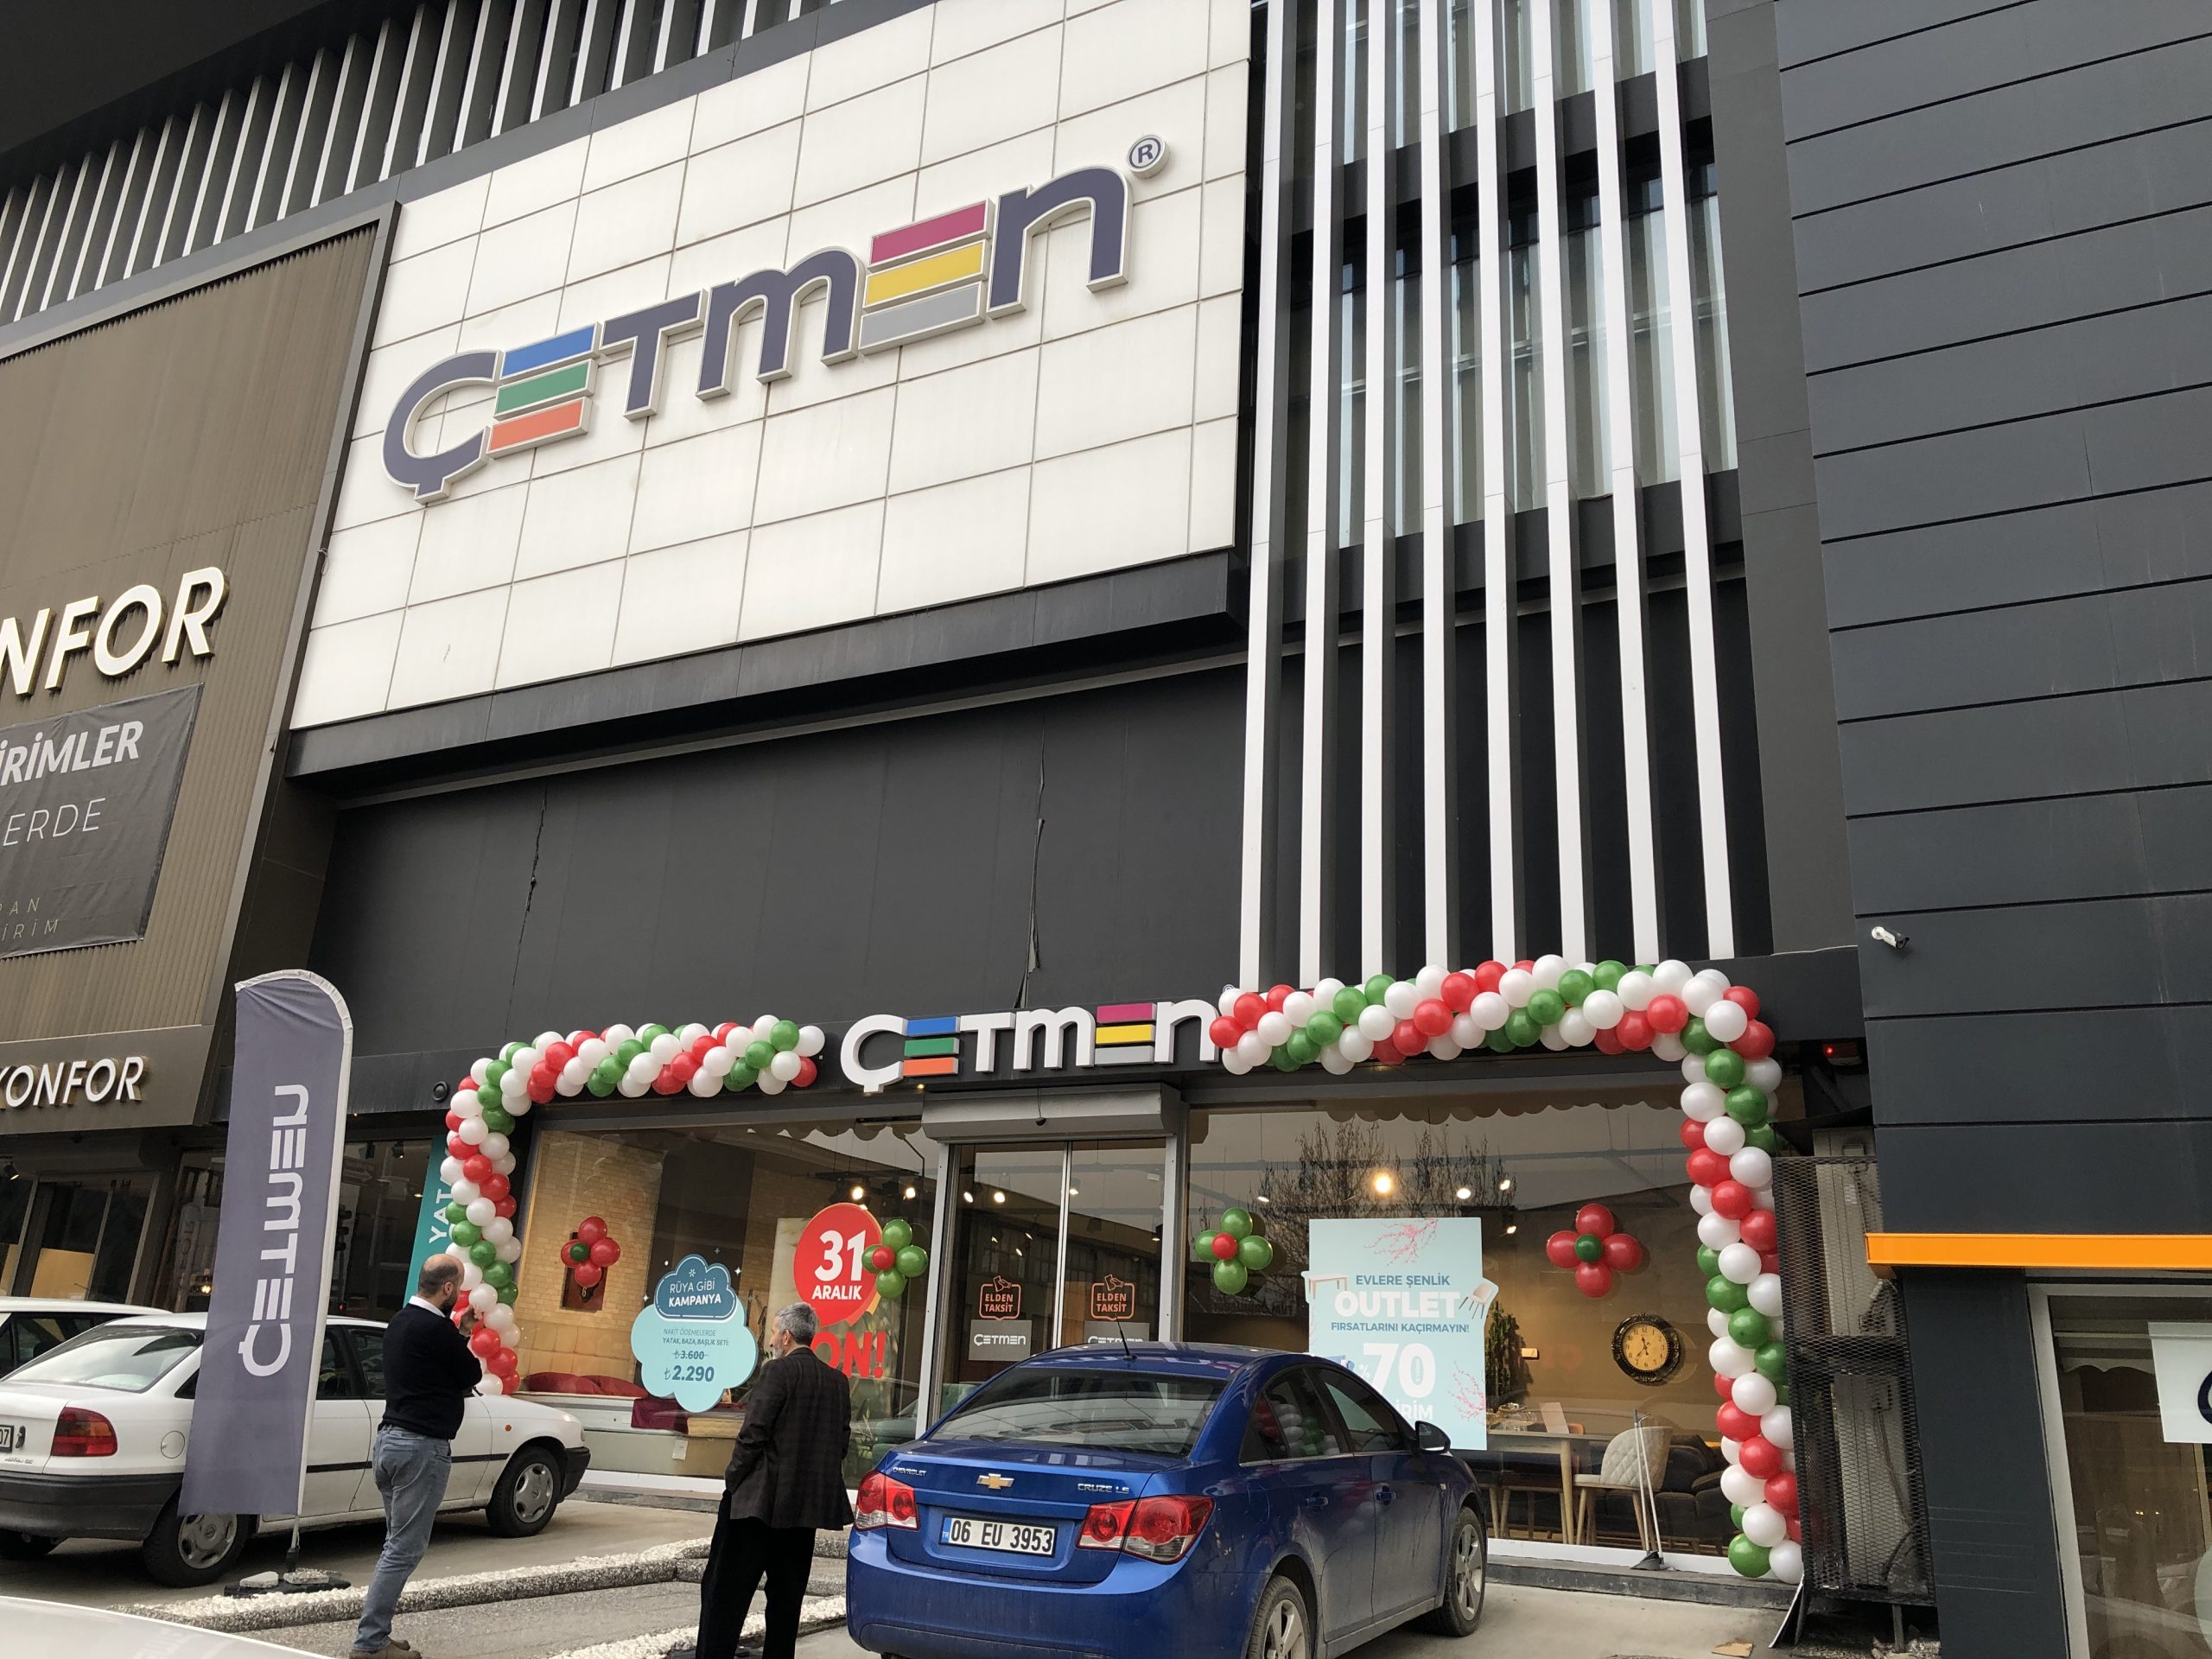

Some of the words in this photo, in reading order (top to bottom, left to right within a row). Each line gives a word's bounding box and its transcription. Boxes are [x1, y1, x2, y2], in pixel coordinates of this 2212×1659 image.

[0, 567, 229, 696] NFOR
[3, 798, 105, 847] ERDE
[814, 1230, 866, 1281] 31
[670, 1281, 694, 1294] RÜYA
[696, 1278, 715, 1291] GİBİ
[1356, 1274, 1402, 1286] EVLERE
[1406, 1273, 1451, 1287] ŞENLİK
[811, 1285, 862, 1300] ARALIK
[985, 1294, 1014, 1302] ELDEN
[1096, 1293, 1127, 1302] ELDEN
[669, 1294, 721, 1307] KAMPANYA
[985, 1302, 1014, 1313] TAKSİT
[1096, 1302, 1127, 1313] TAKSİT
[1334, 1291, 1460, 1319] OUTLET
[1331, 1322, 1399, 1332] FIRSATLARINI
[1401, 1323, 1470, 1334] KAÇIRMAYIN!
[810, 1331, 887, 1379] ON!
[893, 1466, 926, 1477] CHEVROLET
[1077, 1483, 1113, 1493] CRUZE
[942, 1530, 950, 1539] TR
[951, 1519, 971, 1543] 06
[981, 1522, 1003, 1547] EU
[1010, 1526, 1053, 1553] 3953
